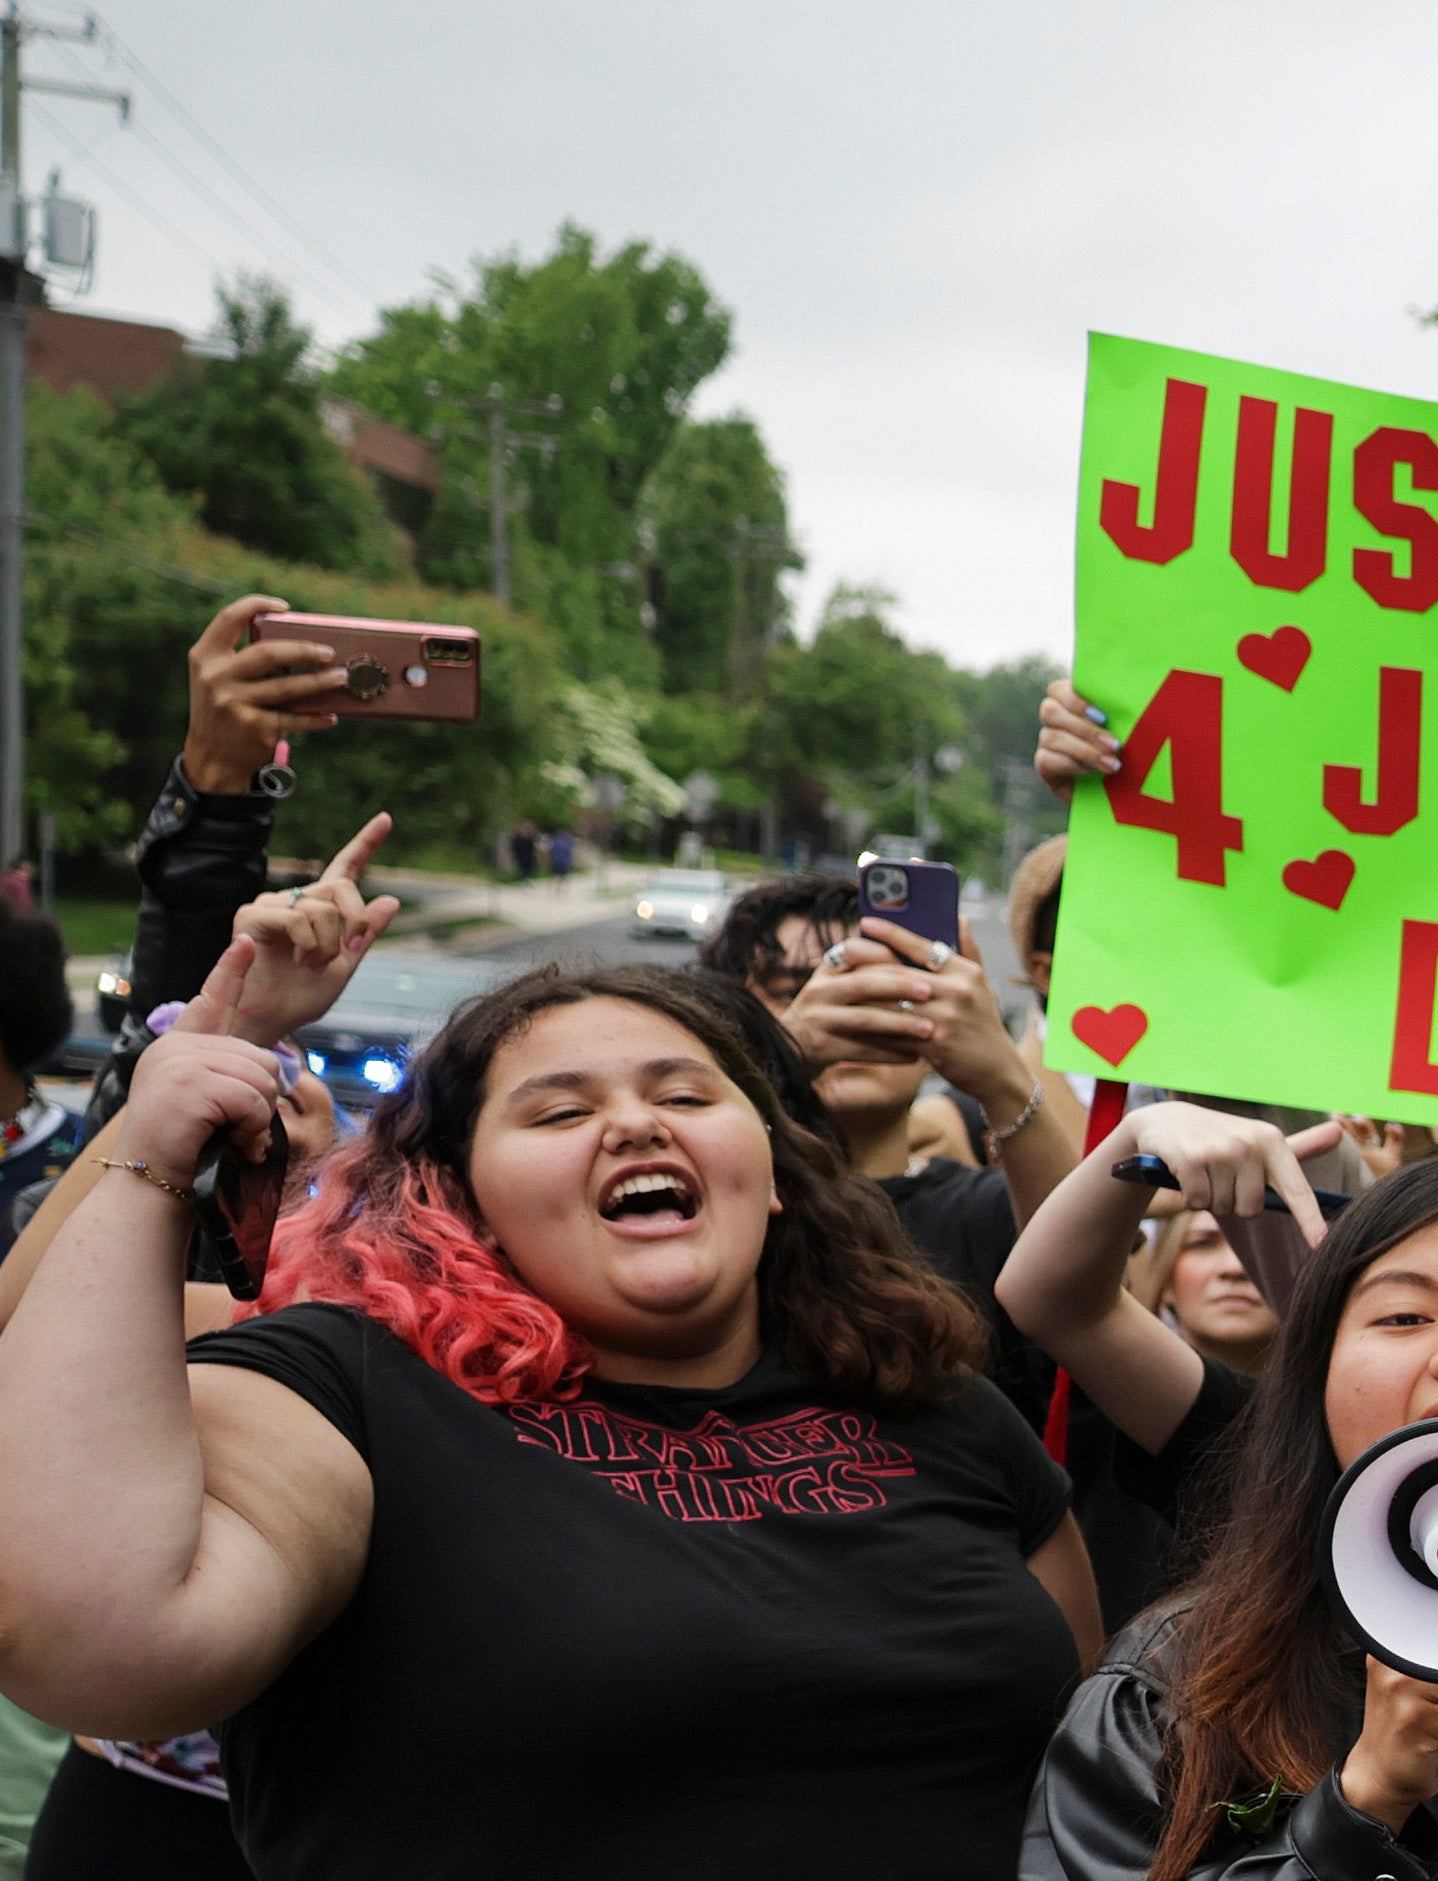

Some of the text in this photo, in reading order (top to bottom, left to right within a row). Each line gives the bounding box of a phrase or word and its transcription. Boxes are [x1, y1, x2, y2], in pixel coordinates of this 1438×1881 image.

[1103, 667, 1244, 888] 4
[509, 1402, 914, 1468] STRANGER
[593, 1461, 887, 1523] THINGS
